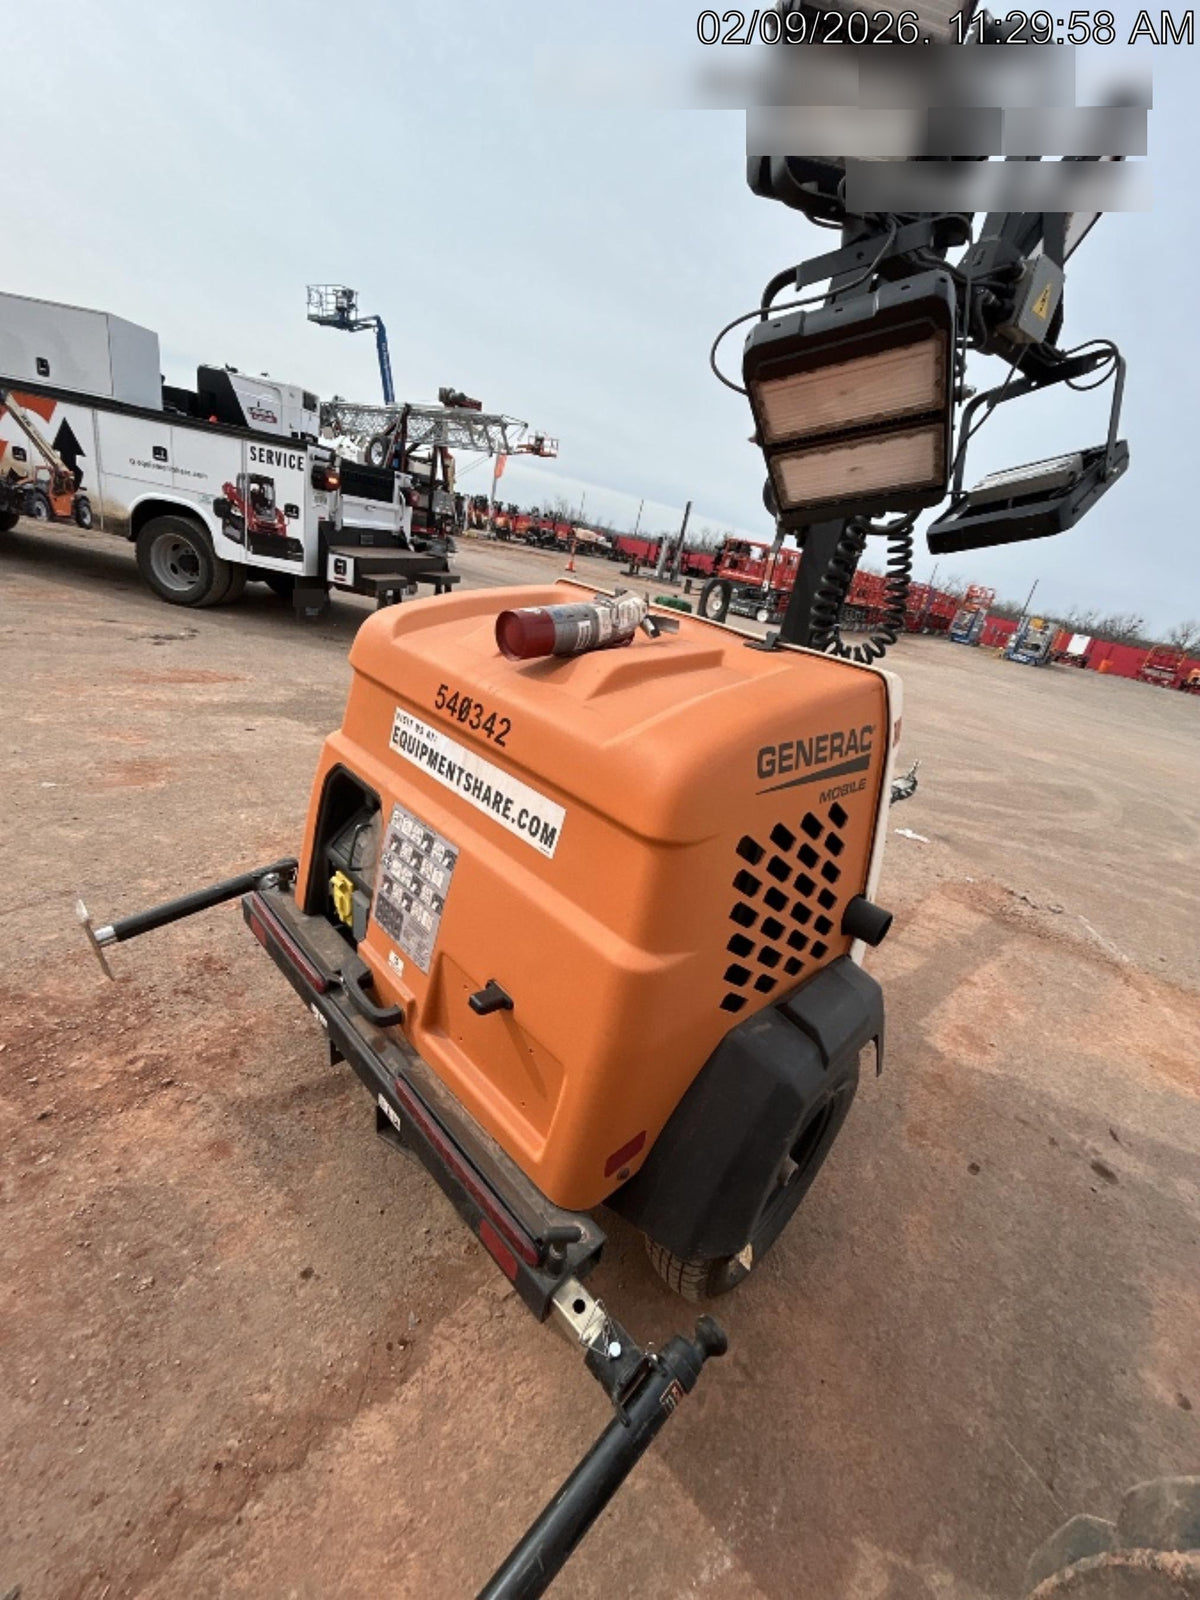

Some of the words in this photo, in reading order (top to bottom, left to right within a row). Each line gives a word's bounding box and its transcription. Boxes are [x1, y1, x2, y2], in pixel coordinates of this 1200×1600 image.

[250, 445, 305, 472] SERVICE
[434, 684, 511, 747] 540342
[757, 725, 873, 779] GENERAC
[392, 725, 557, 848] EQUIPMENTSHARE.COM
[819, 778, 867, 804] MOBILE
